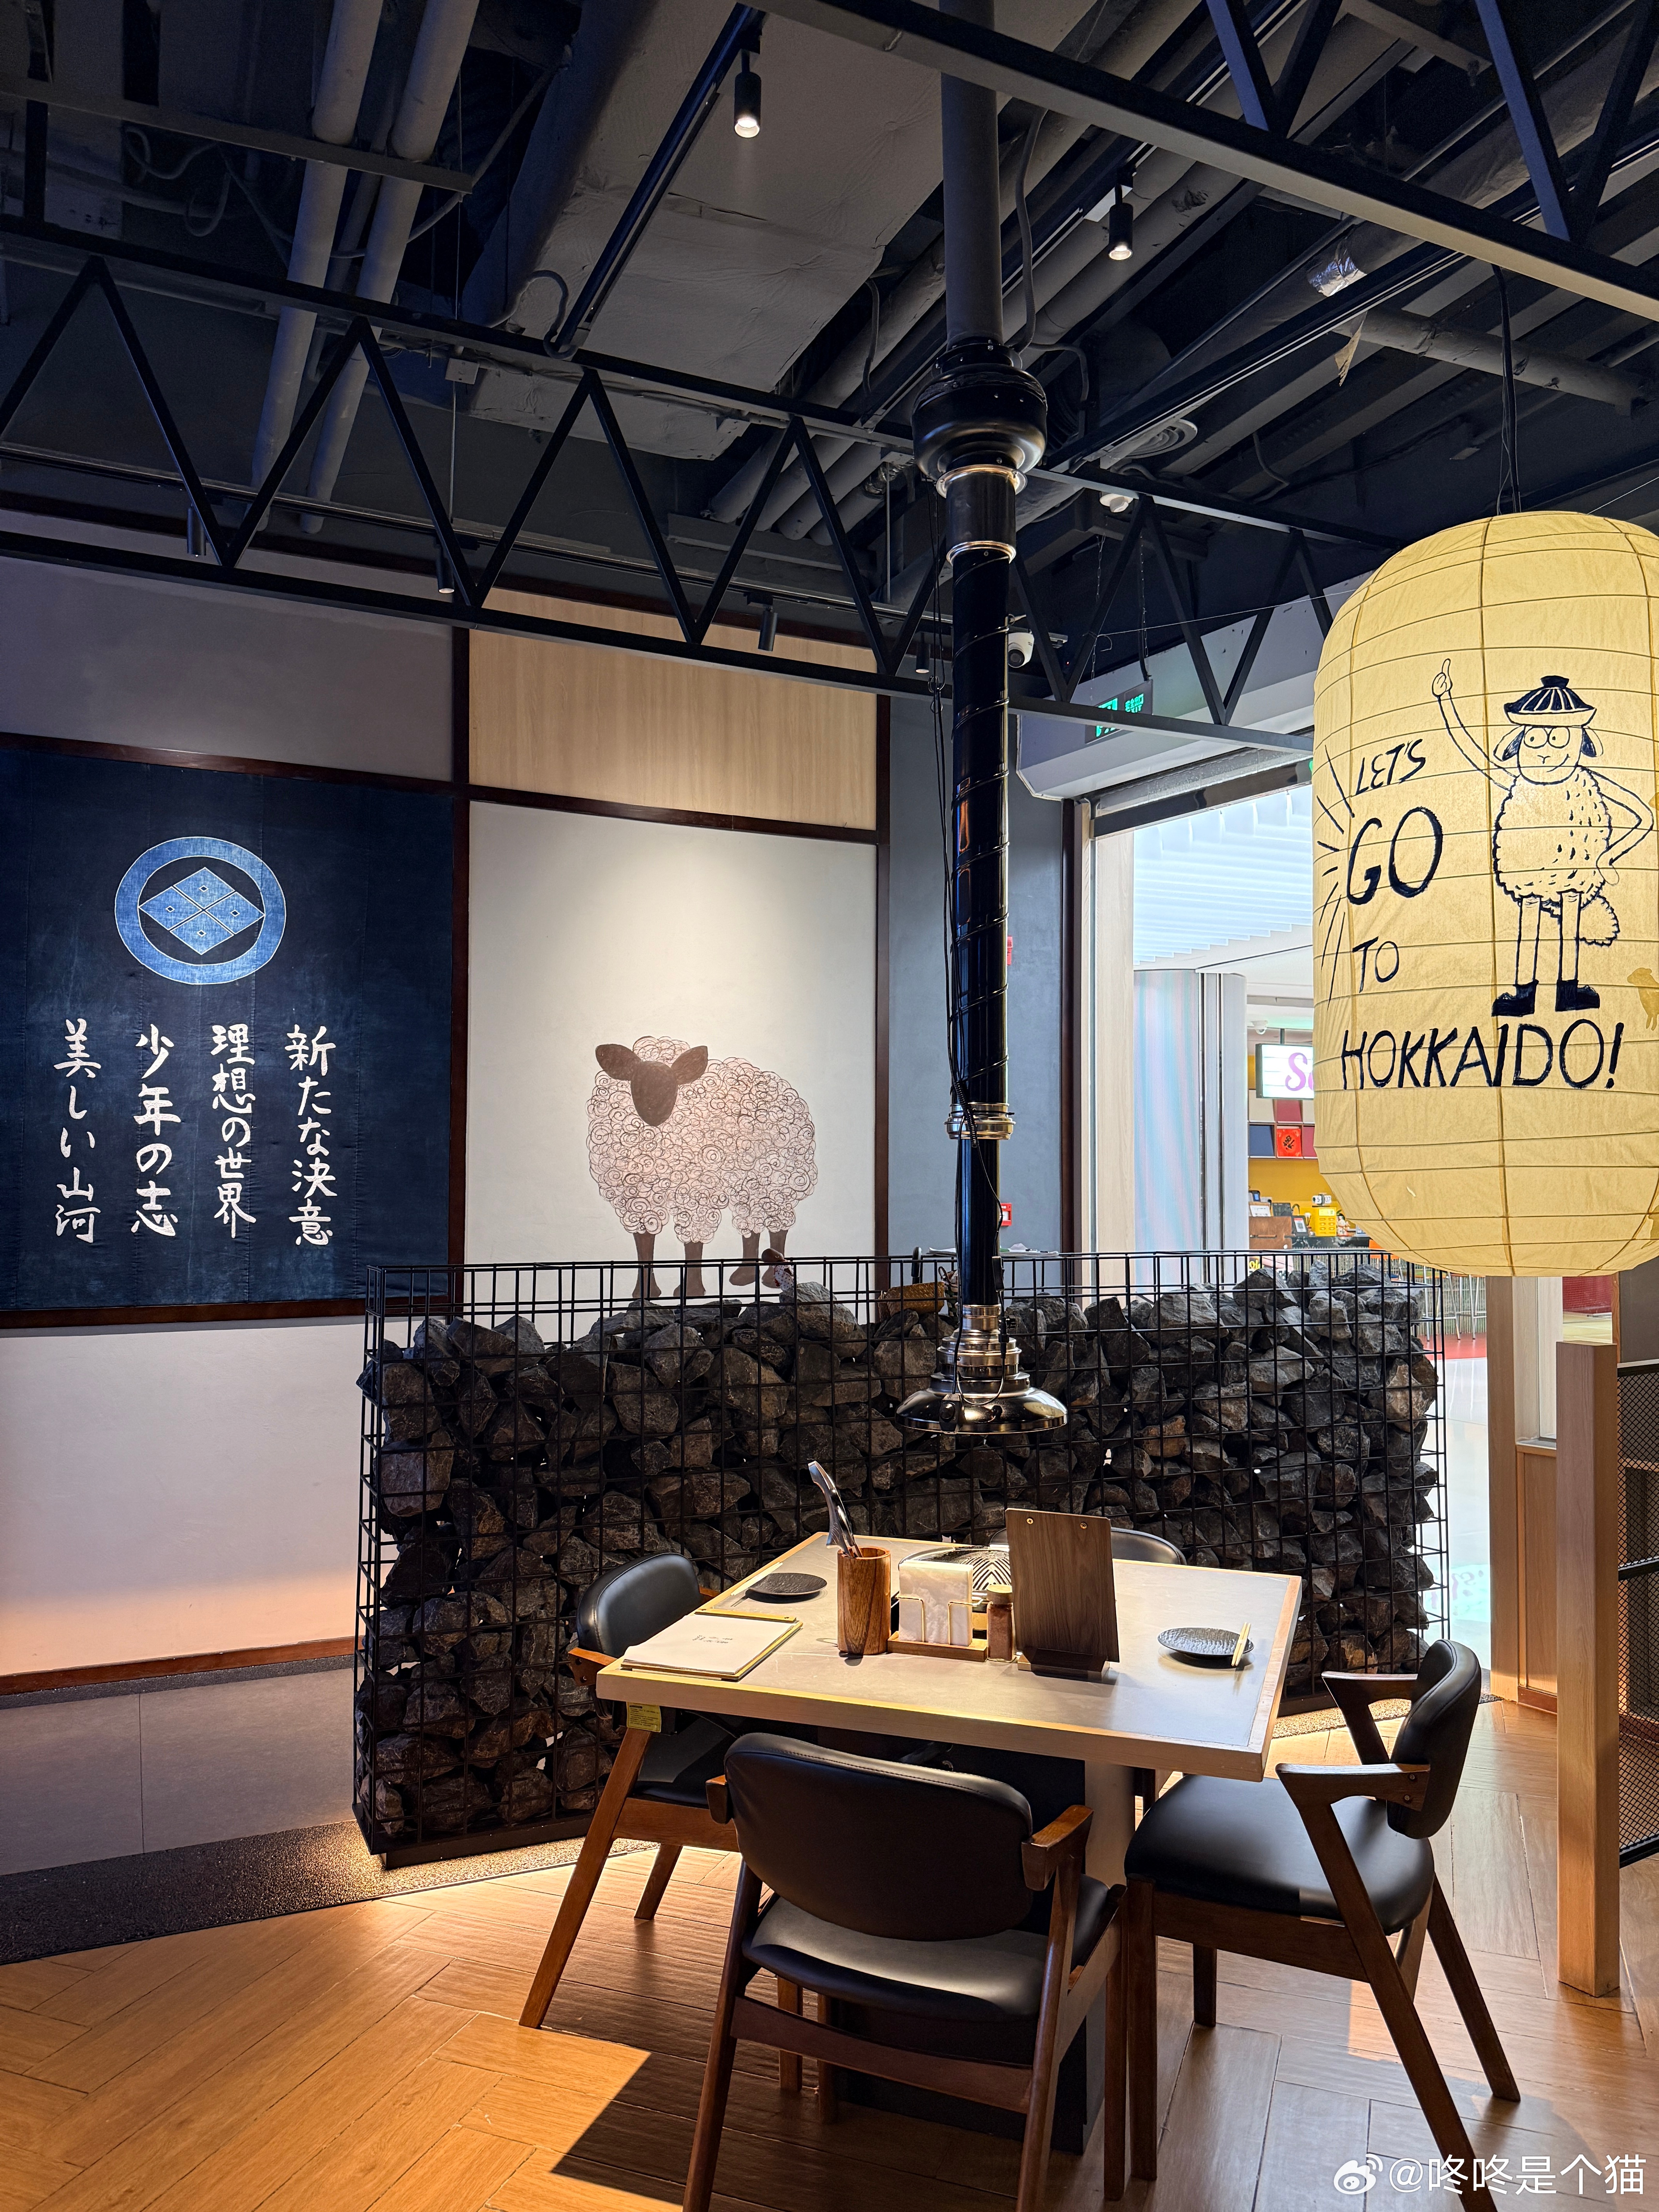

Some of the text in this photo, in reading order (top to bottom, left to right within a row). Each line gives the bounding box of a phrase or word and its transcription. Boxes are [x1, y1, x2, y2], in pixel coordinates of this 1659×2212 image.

[1347, 806, 1443, 905] GO
[1341, 1019, 1624, 1089] HOKKAIDO!
[1352, 936, 1399, 993] TO
[54, 1018, 101, 1243] 美しい山河
[131, 1024, 181, 1237] 少年の志
[210, 1024, 256, 1238] 理想の世界
[285, 1025, 337, 1245] 新たな決意
